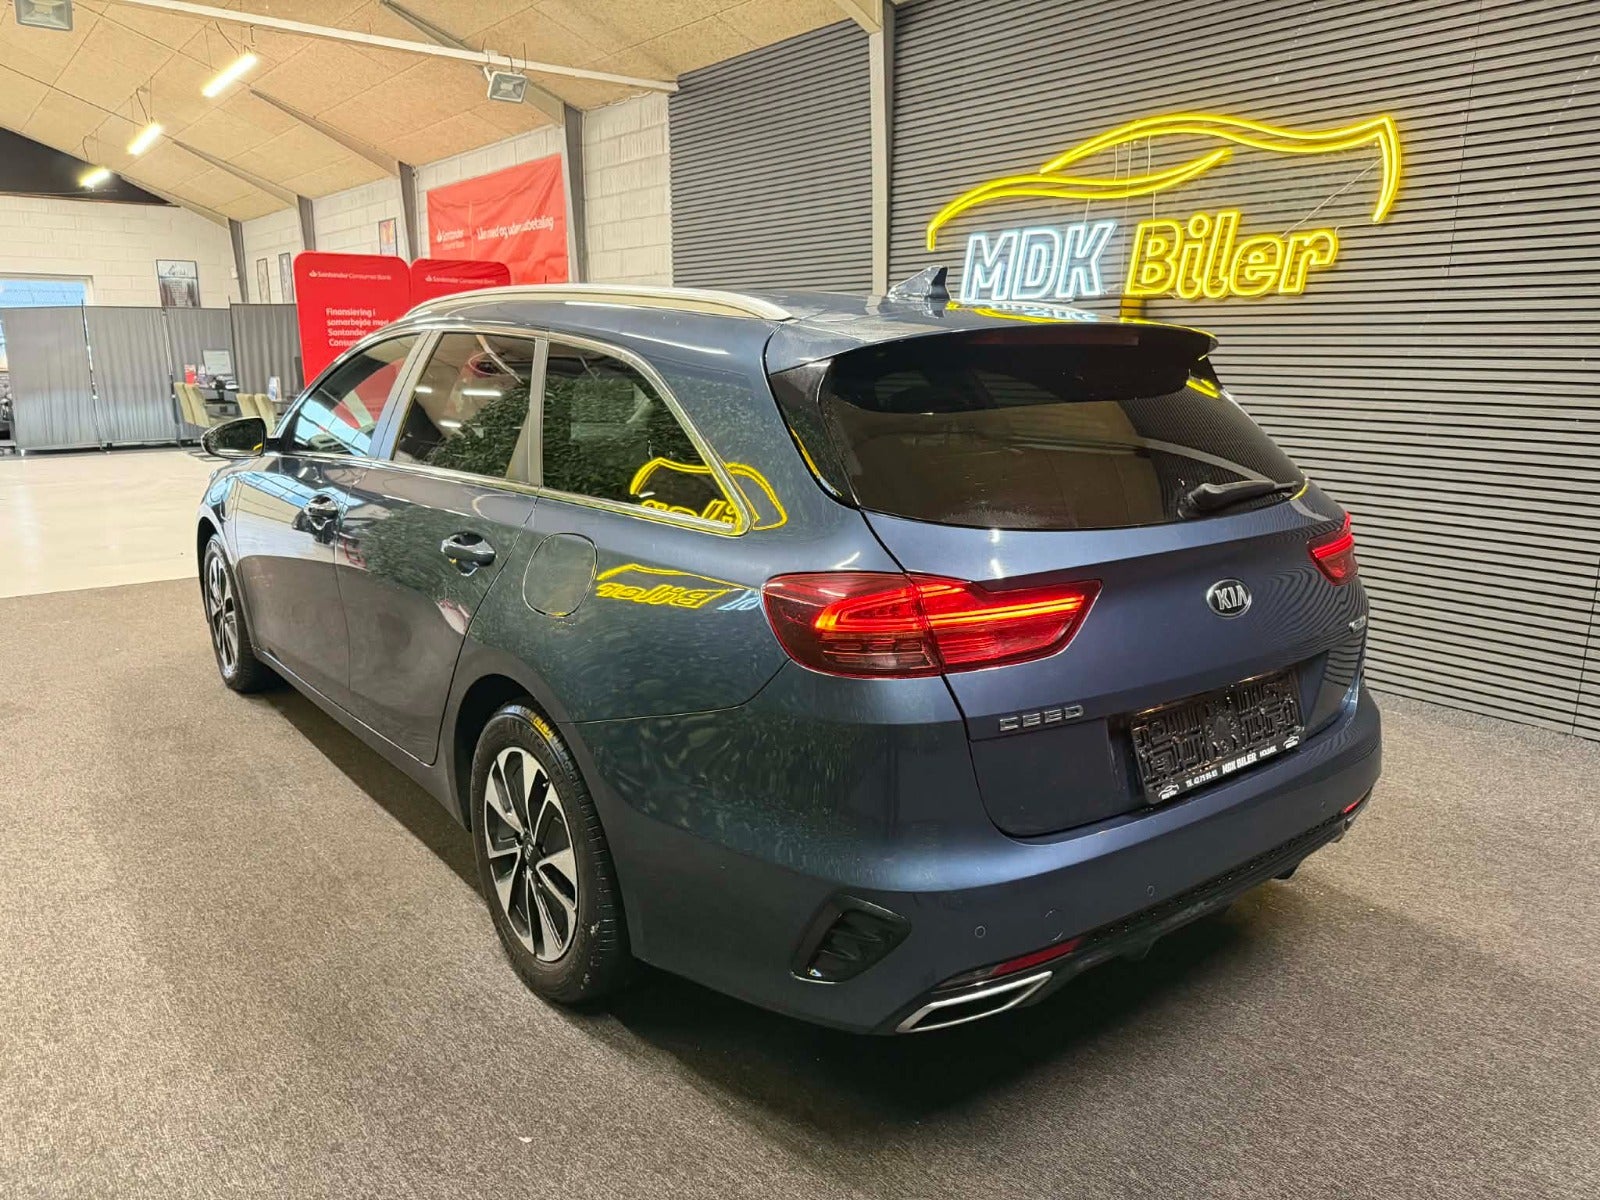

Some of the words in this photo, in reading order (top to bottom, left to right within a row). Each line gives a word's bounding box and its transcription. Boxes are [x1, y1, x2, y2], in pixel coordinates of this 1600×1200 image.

[960, 221, 1115, 300] MDK
[1124, 210, 1339, 300] Biler
[317, 271, 348, 279] Santander
[326, 307, 373, 318] Finansiering
[327, 318, 371, 328] samarbejde
[328, 328, 367, 337] Santander
[1215, 585, 1249, 610] KIA
[999, 704, 1085, 732] CEED
[1236, 752, 1257, 769] BILER
